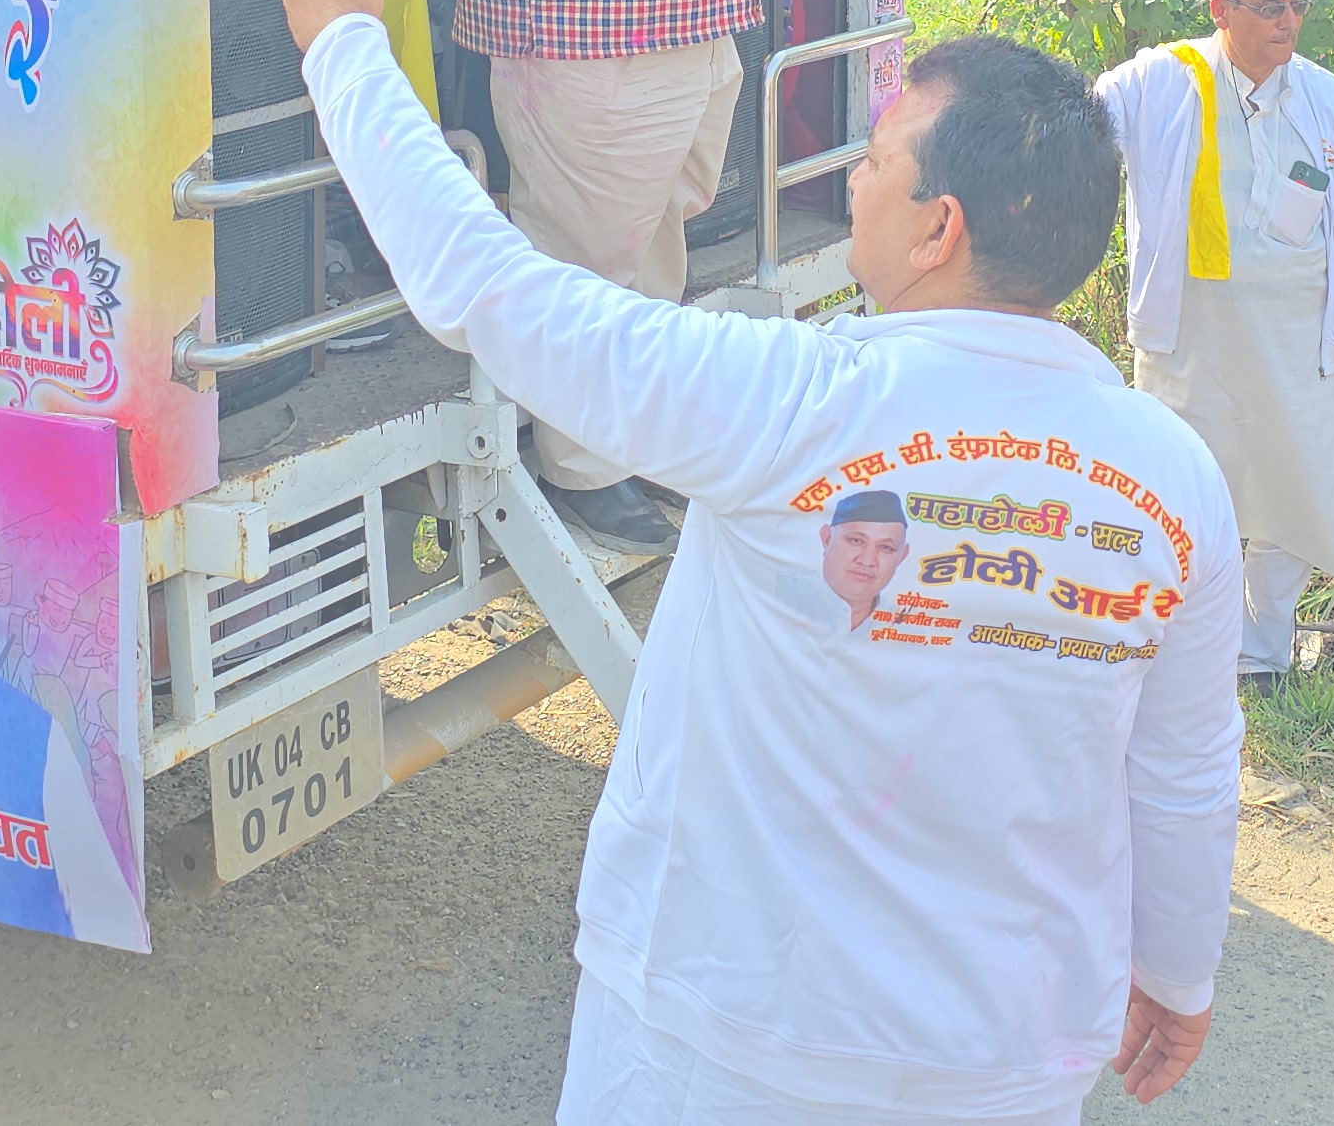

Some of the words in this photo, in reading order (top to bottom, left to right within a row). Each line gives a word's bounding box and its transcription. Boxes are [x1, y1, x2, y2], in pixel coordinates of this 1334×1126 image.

[789, 475, 842, 514] एल.
[840, 451, 897, 486] एस.
[898, 430, 942, 466] सी.
[1045, 437, 1082, 475] लि.
[1088, 458, 1142, 502] द्वारा
[906, 492, 1072, 542] महाहोली
[1091, 520, 1143, 557] सल्ट
[918, 540, 1045, 594] होली
[1046, 576, 1152, 623] आई
[1151, 587, 1185, 622] रे
[1057, 636, 1106, 660] प्रयास
[227, 742, 265, 800] UK
[274, 724, 303, 778] 04
[320, 700, 351, 751] CB
[242, 755, 352, 854] 0701
